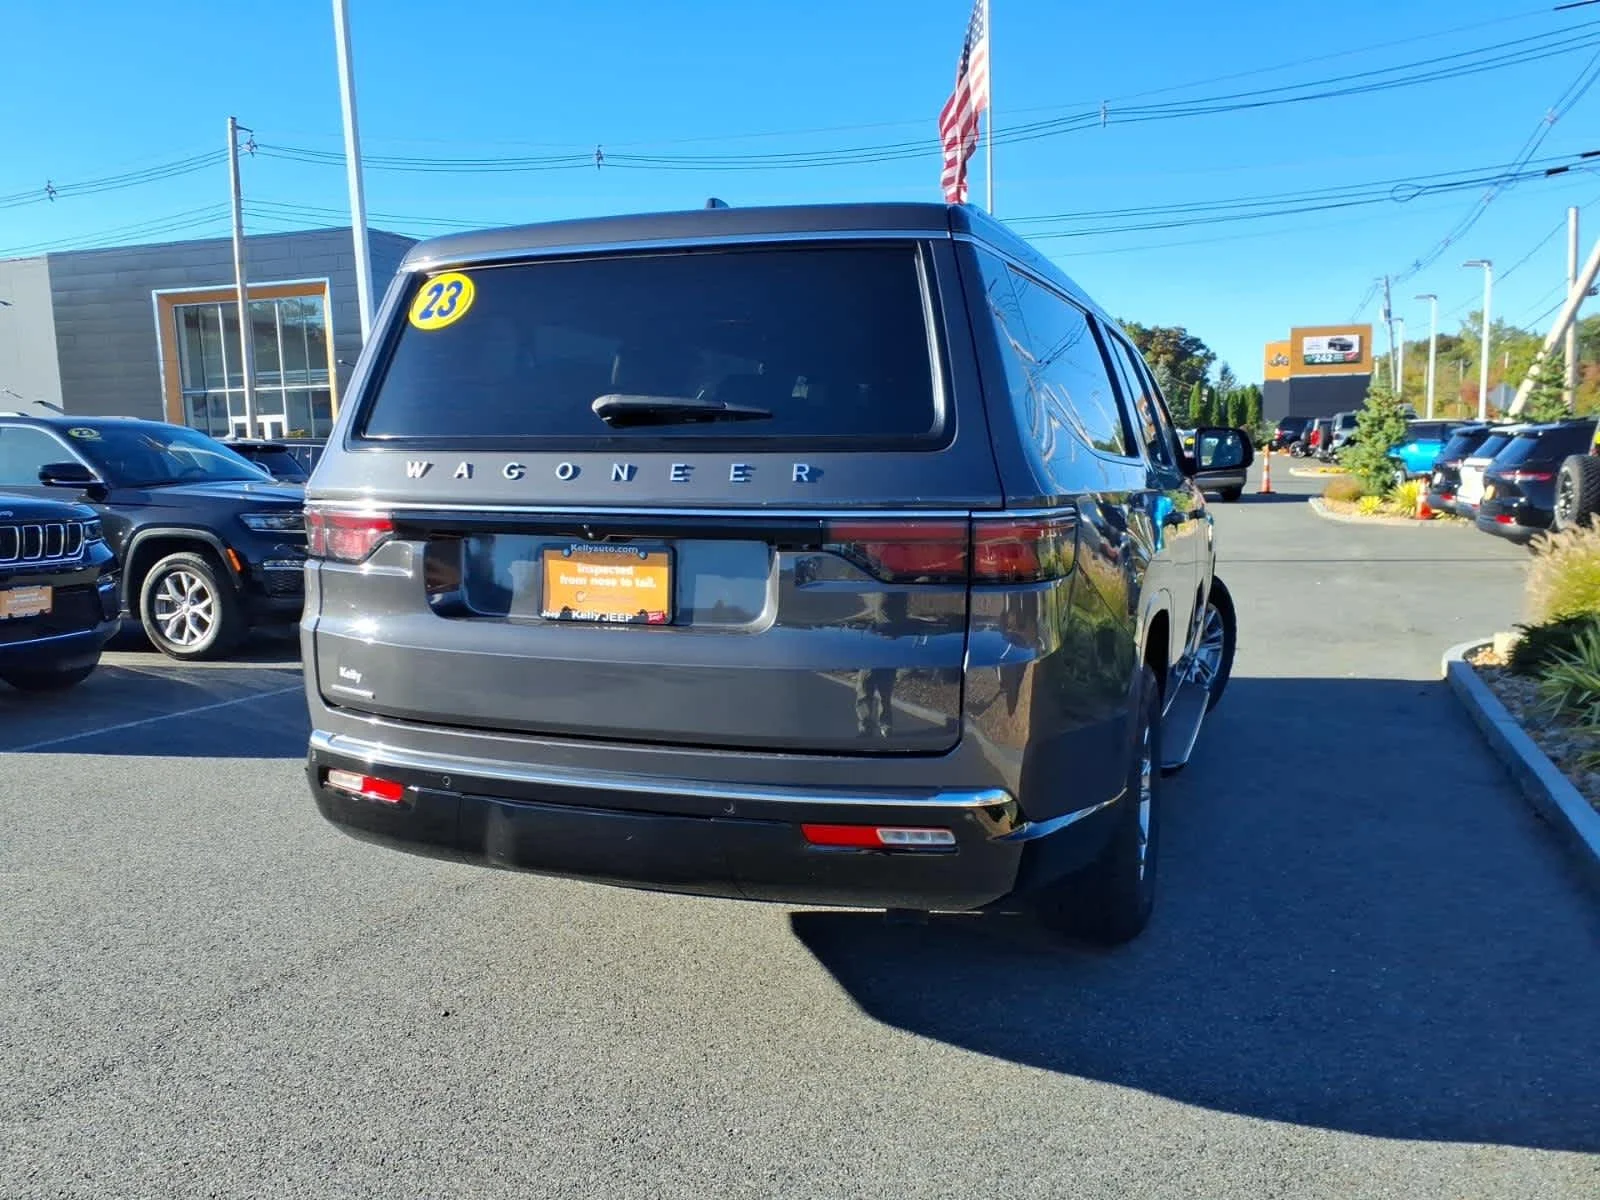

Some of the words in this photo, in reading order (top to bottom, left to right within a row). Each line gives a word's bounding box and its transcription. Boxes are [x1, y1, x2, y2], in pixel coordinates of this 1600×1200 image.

[418, 280, 464, 321] 23
[405, 460, 811, 482] WAGONEER
[570, 543, 639, 554] Kellyauto.com
[559, 575, 588, 585] from
[620, 578, 633, 588] to
[571, 609, 601, 621] Kelly
[602, 613, 633, 622] JEEP
[338, 666, 363, 684] Kelly
